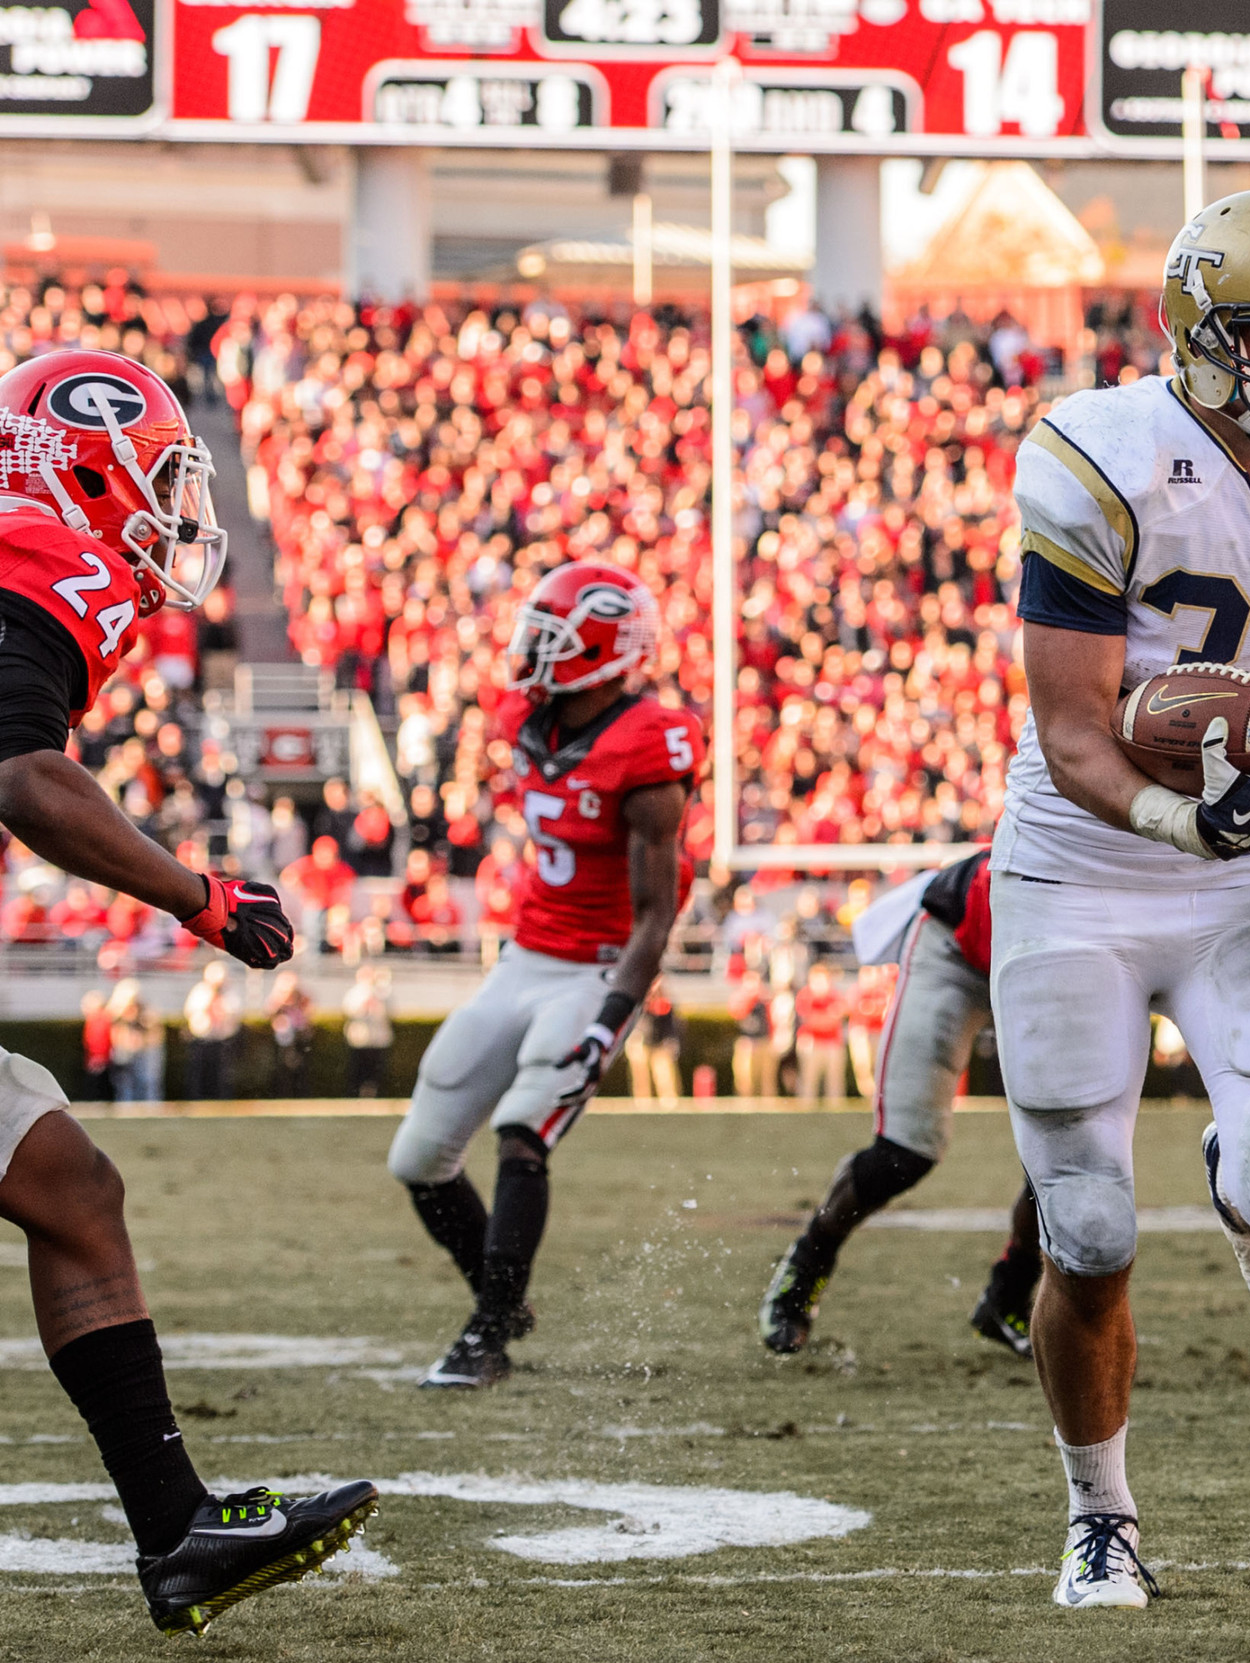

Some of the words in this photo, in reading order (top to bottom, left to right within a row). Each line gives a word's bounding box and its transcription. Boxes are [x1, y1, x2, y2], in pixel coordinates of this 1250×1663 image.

[212, 15, 321, 122] 17
[948, 30, 1064, 137] 14
[1167, 477, 1203, 485] RUSSELL
[51, 552, 135, 658] 24
[664, 726, 694, 772] 5
[524, 790, 577, 887] 5
